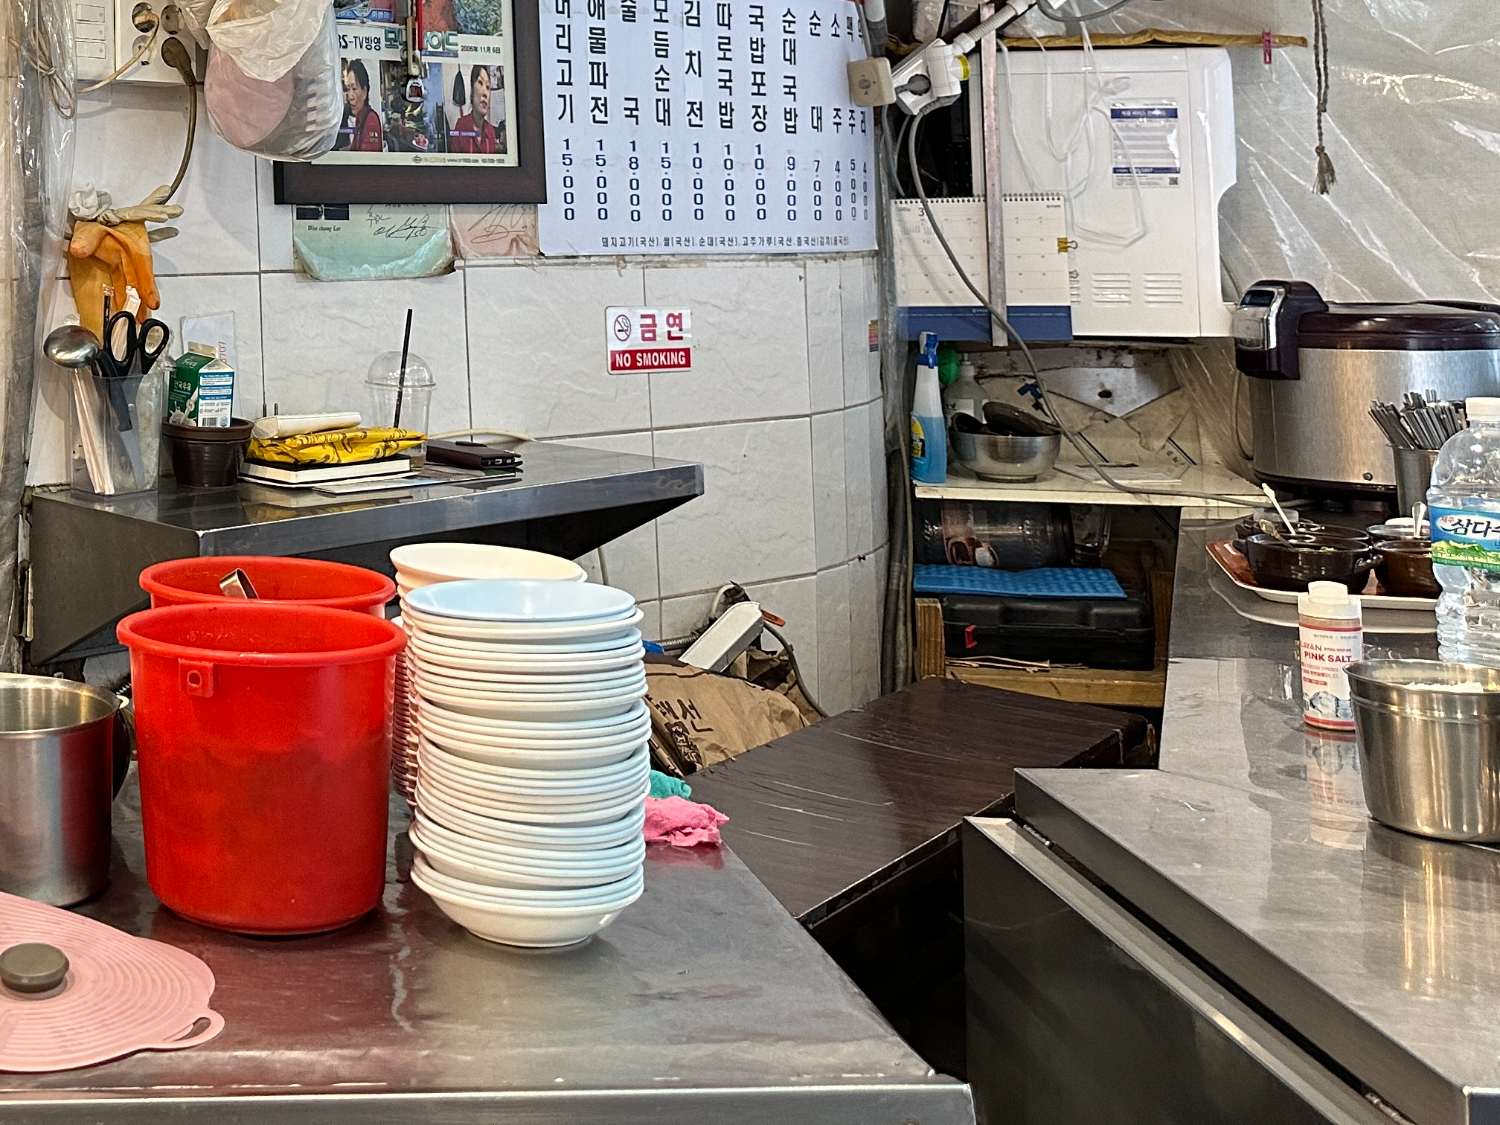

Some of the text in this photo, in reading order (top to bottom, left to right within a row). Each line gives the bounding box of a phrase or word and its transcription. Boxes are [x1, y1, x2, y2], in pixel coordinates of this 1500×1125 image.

[684, 0, 703, 128] 김치전
[716, 2, 734, 129] 따로국밥
[749, 5, 767, 132] 국밥포장
[782, 8, 798, 134] 순대국밥
[616, 352, 686, 367] NO SMOKING
[640, 313, 683, 341] 금연
[1304, 650, 1352, 663] PINK SALT
